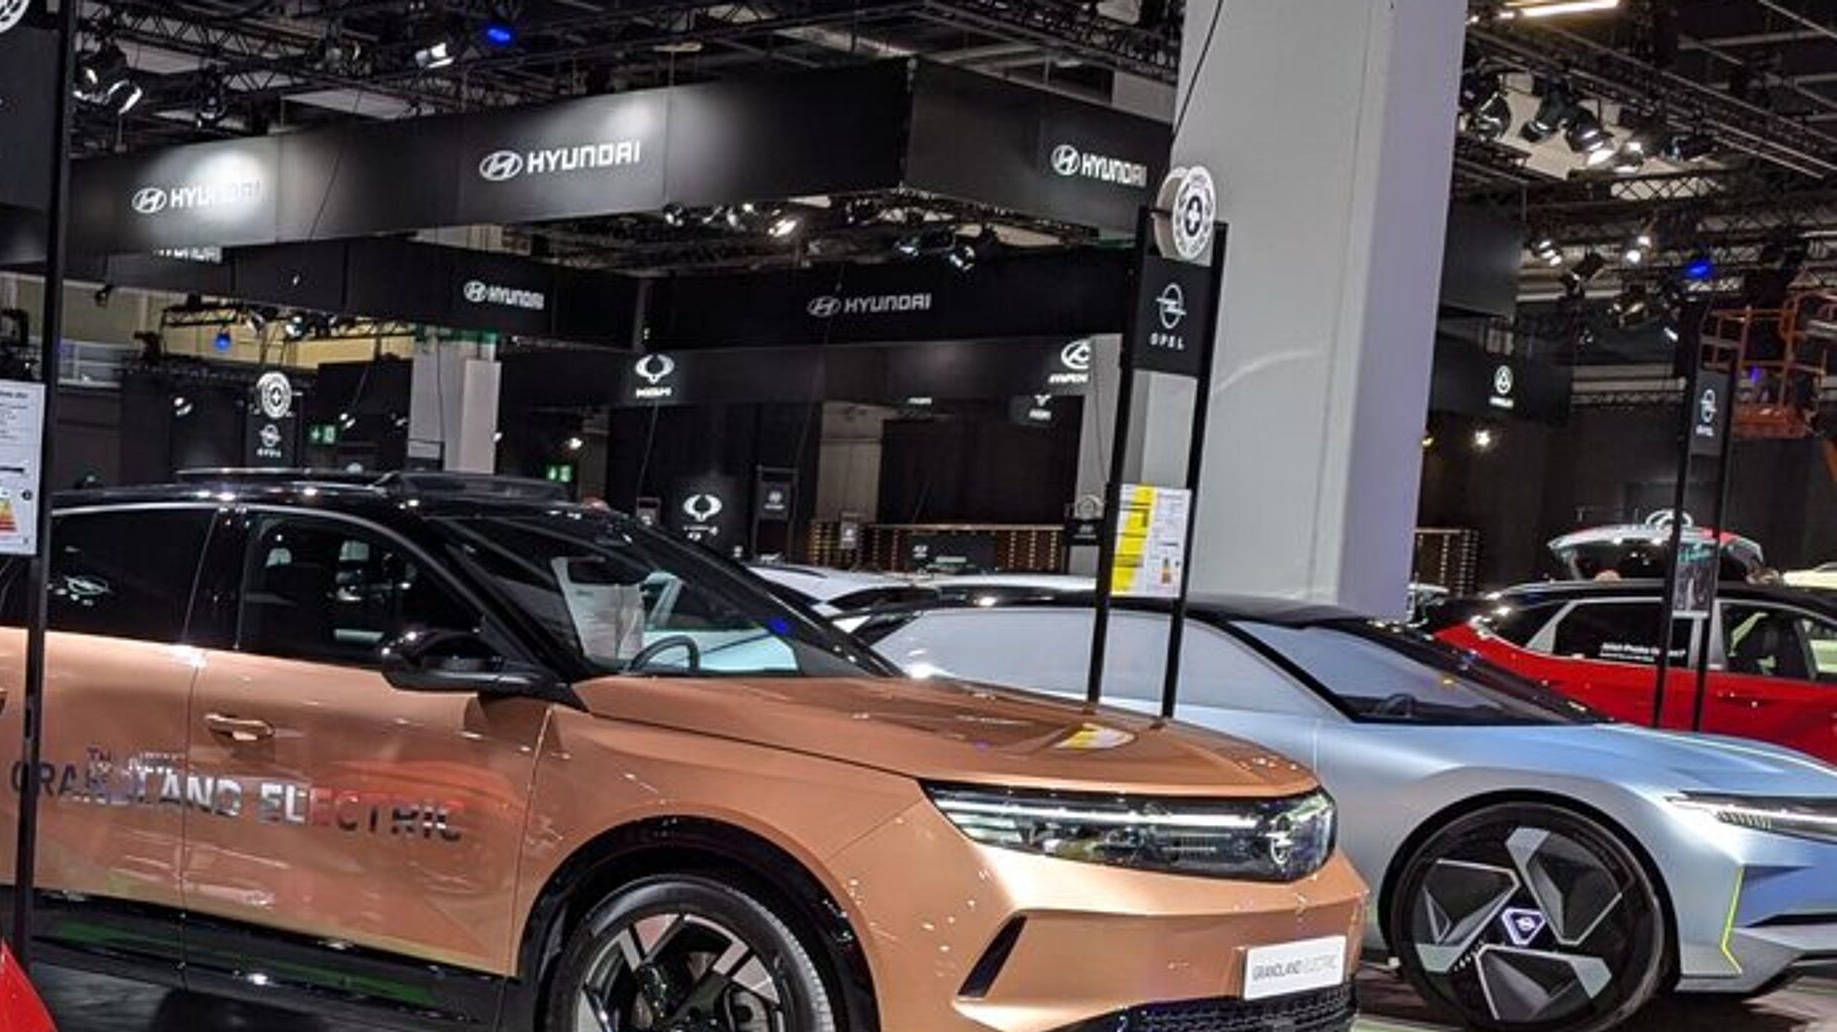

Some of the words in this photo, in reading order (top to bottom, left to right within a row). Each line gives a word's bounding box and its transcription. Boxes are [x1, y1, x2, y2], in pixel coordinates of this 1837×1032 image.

[526, 139, 641, 174] HYUNDAI
[1081, 152, 1148, 188] HYUNDAI
[170, 179, 263, 209] HYUDAI
[486, 285, 545, 310] HYUNDAI
[844, 292, 932, 313] HYUNDAI
[1149, 332, 1185, 350] OPEL
[261, 781, 464, 843] ELECTRIC
